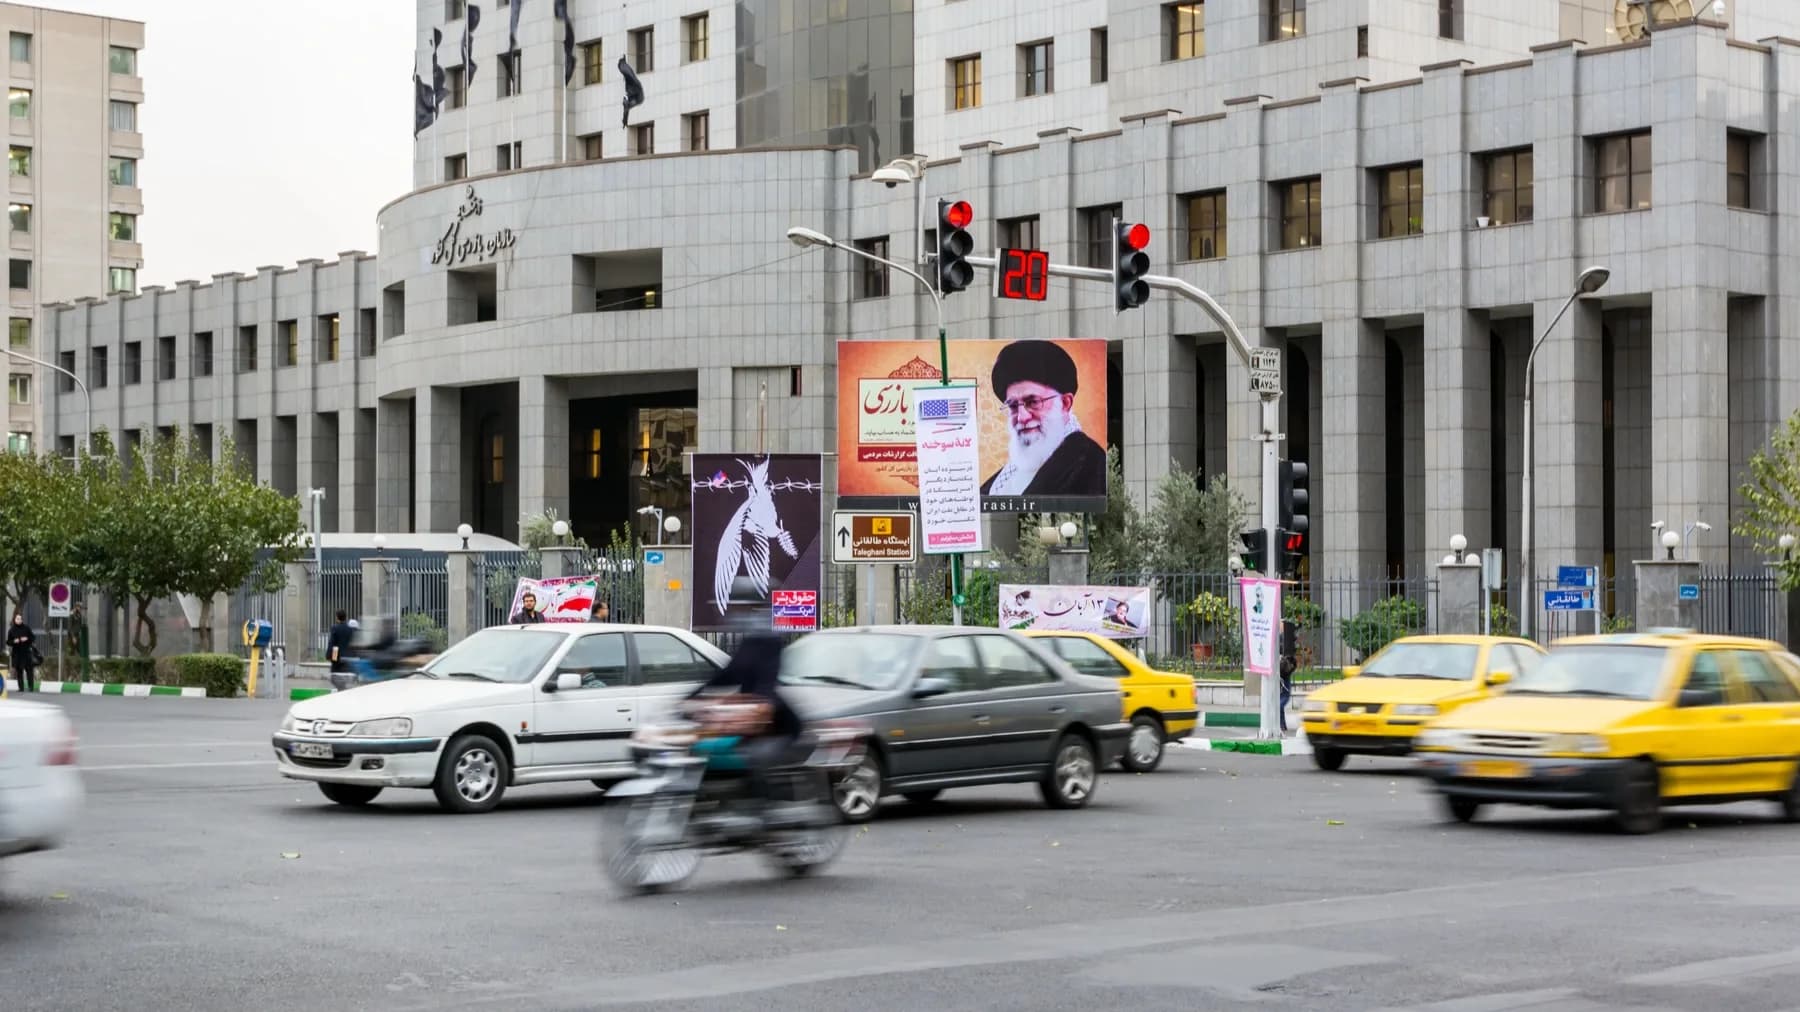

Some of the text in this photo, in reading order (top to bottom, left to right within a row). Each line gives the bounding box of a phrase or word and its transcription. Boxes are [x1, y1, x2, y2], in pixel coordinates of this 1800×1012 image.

[1004, 249, 1047, 300] 20
[863, 384, 908, 425] بازرسی
[852, 535, 910, 548] ایستگاه طالقانی
[853, 547, 910, 558] Taleghani Station
[1547, 594, 1580, 606] طالقانی
